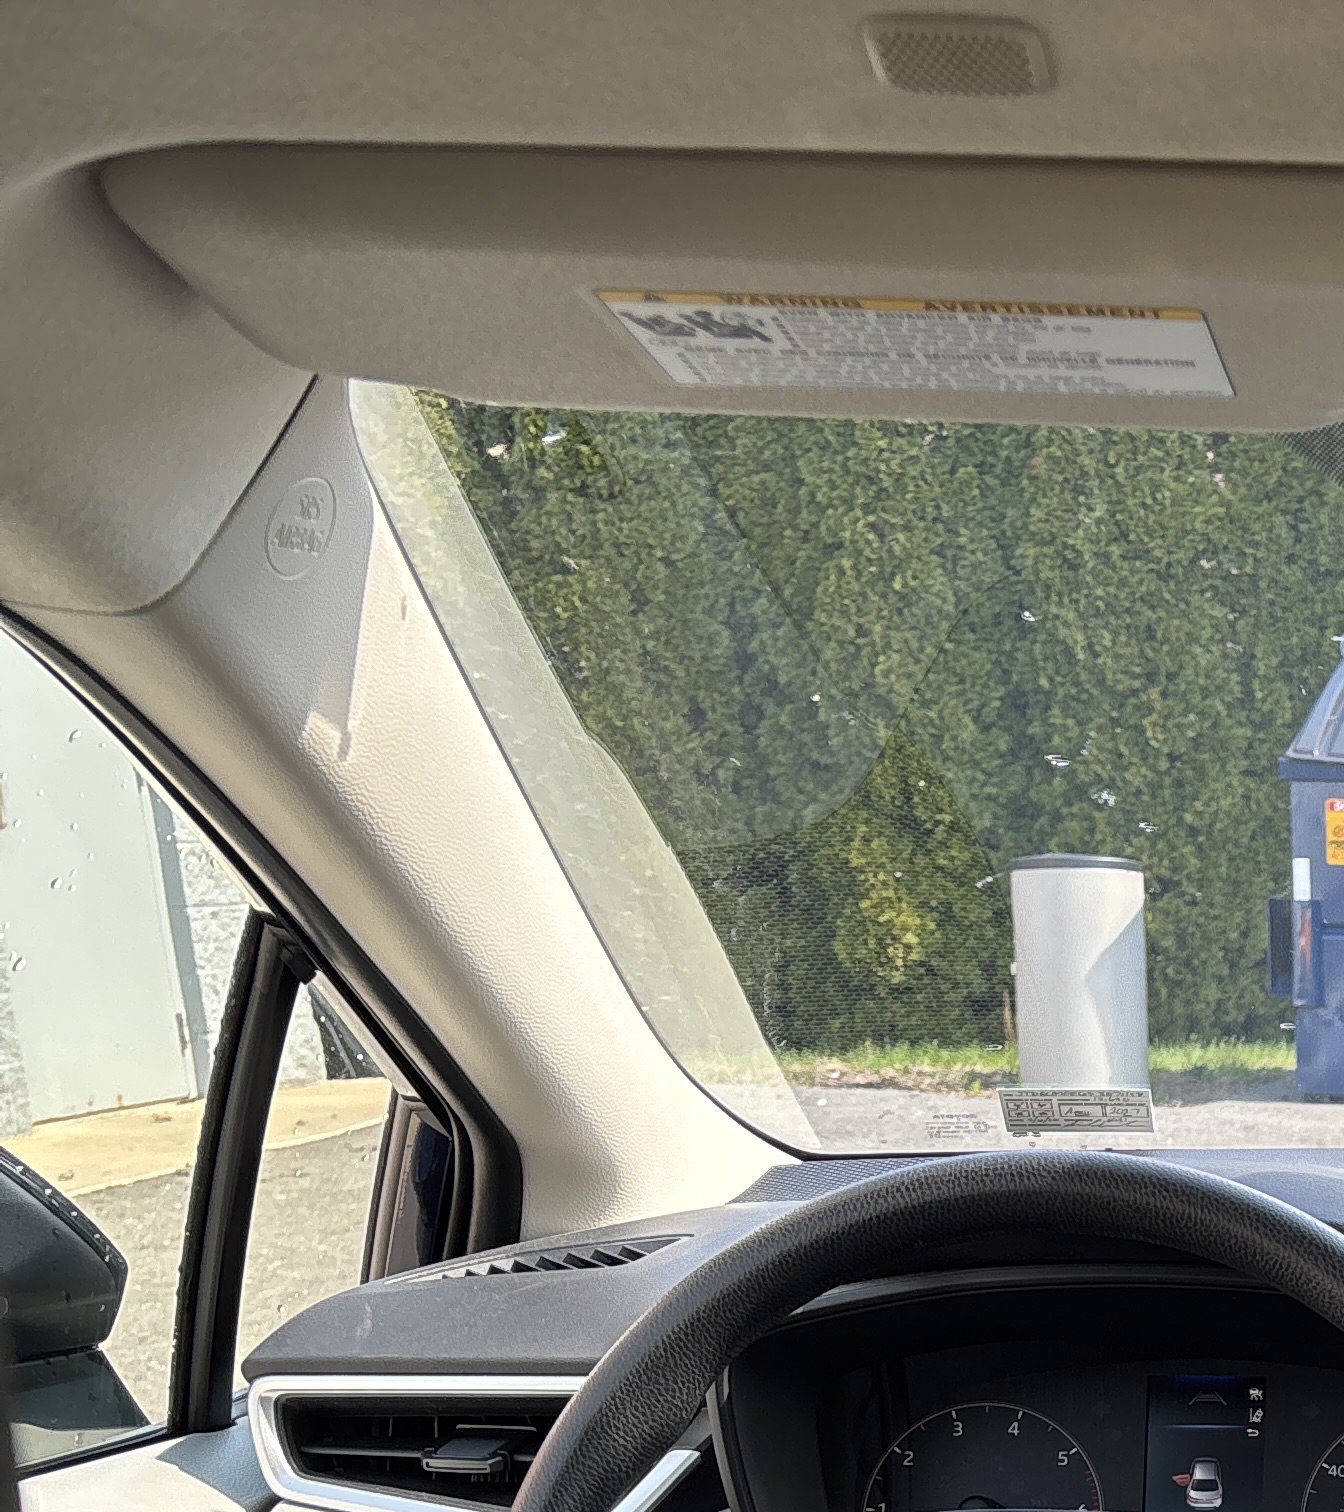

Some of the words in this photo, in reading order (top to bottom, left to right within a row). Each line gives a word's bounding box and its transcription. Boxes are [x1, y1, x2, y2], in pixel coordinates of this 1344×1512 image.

[953, 1422, 963, 1436] 3
[1008, 1422, 1020, 1436] 4
[903, 1451, 914, 1466] 2
[1057, 1451, 1069, 1466] 5
